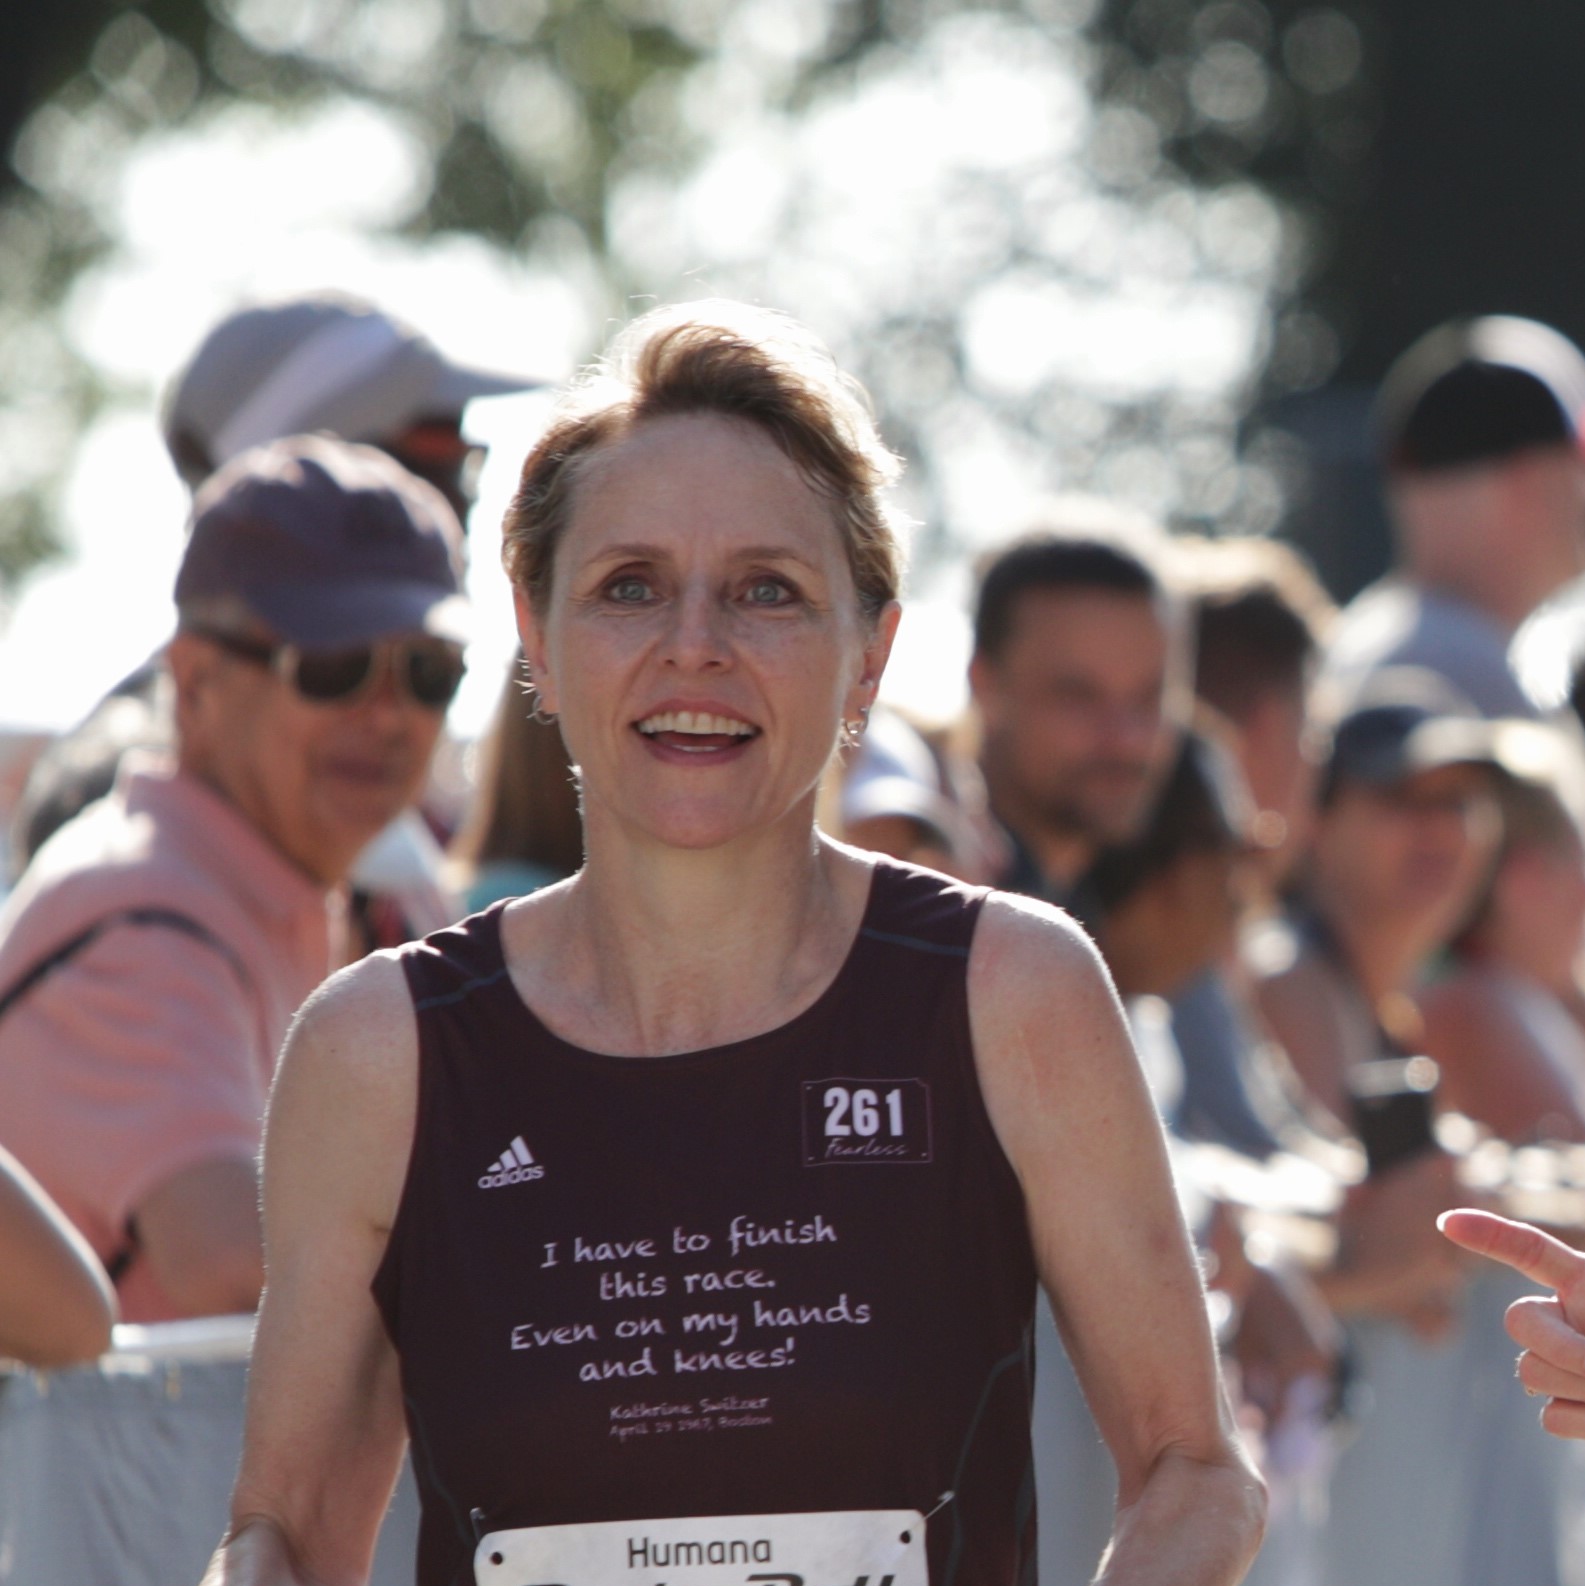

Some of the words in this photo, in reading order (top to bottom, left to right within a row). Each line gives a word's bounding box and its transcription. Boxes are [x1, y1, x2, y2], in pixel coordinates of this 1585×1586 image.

[822, 1086, 904, 1137] 261
[824, 1137, 909, 1158] Fearless
[478, 1164, 545, 1189] adidas
[540, 1243, 560, 1268] I
[574, 1237, 657, 1264] have
[673, 1226, 710, 1254] to
[728, 1215, 838, 1257] finish
[600, 1272, 667, 1300] this
[685, 1267, 776, 1294] race.
[511, 1323, 598, 1350] Even
[615, 1317, 666, 1338] on
[683, 1313, 739, 1346] my
[754, 1294, 871, 1328] hands
[579, 1348, 657, 1381] and
[675, 1337, 796, 1373] knees!
[628, 1538, 772, 1568] Humana
